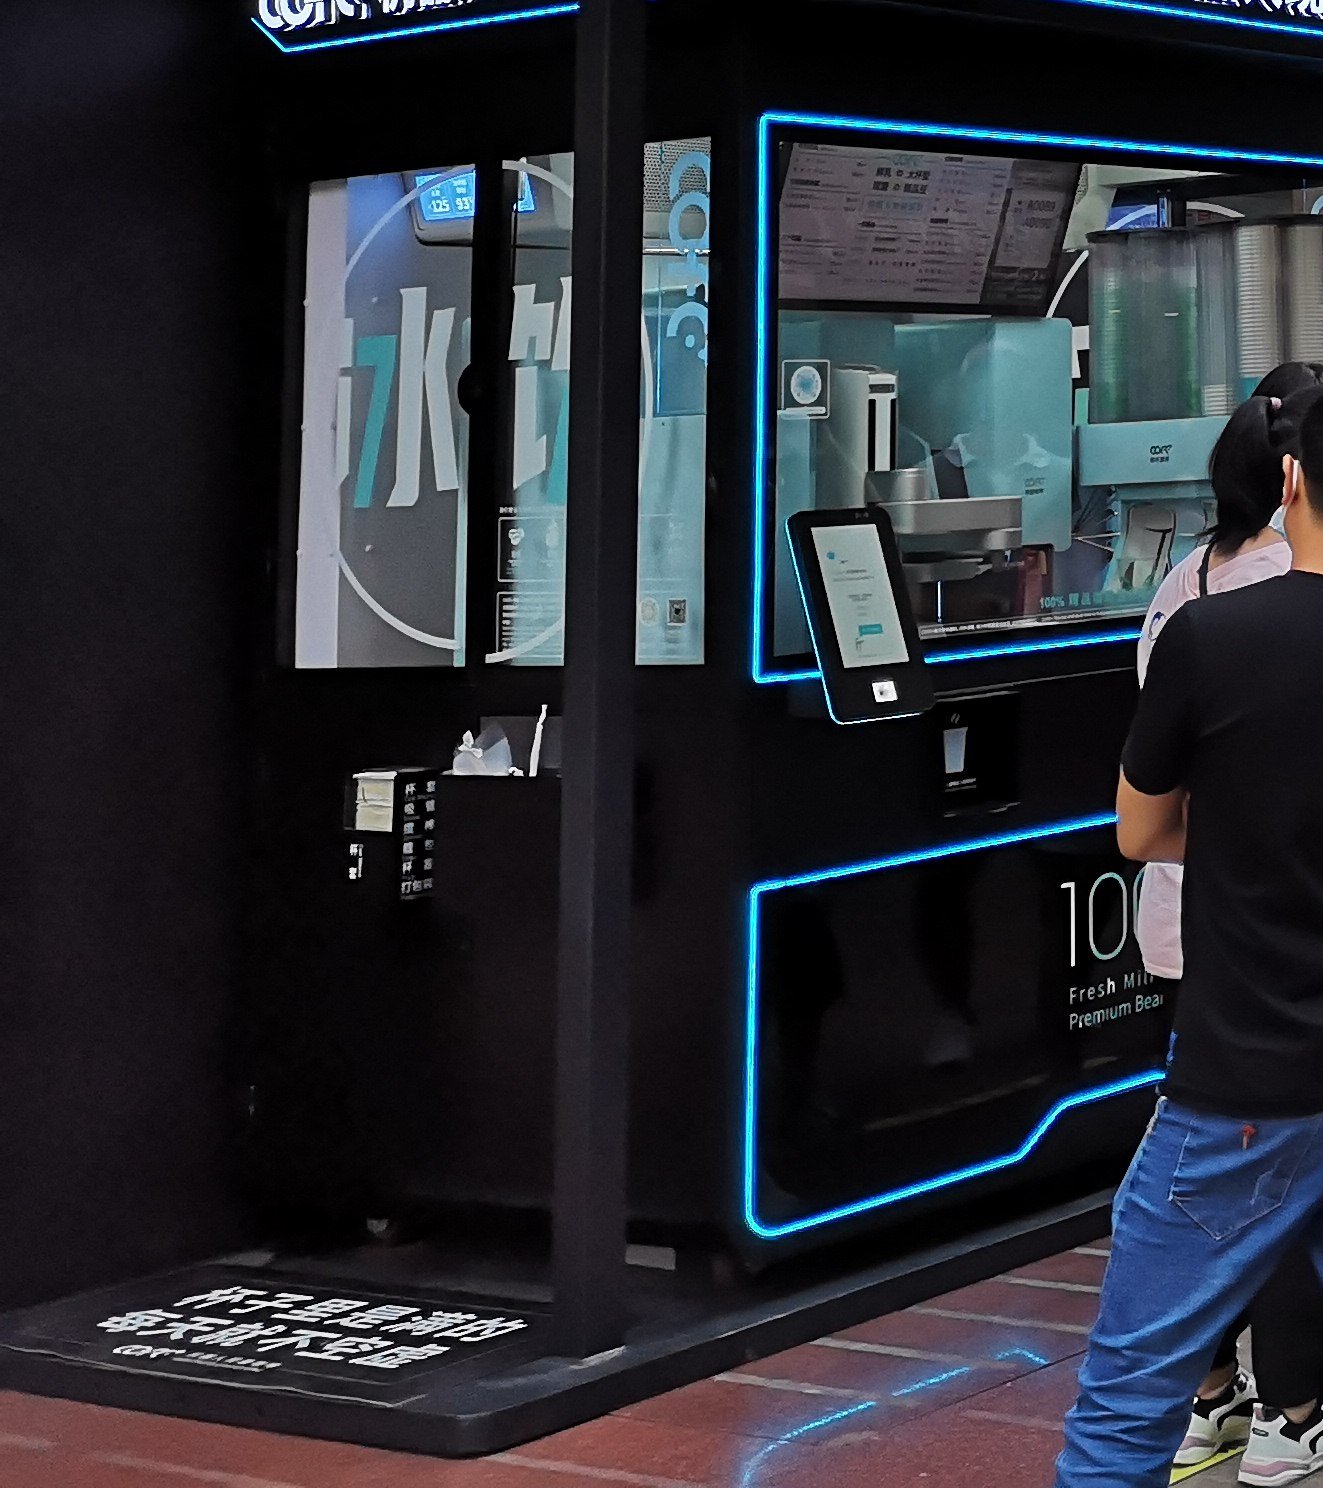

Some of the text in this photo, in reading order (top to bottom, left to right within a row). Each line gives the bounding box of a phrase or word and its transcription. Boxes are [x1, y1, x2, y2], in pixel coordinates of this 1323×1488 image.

[1060, 871, 1148, 968] 10
[1069, 977, 1116, 1005] Fresh
[1069, 1001, 1132, 1031] Premium
[173, 1285, 529, 1343] 杯子里是满的
